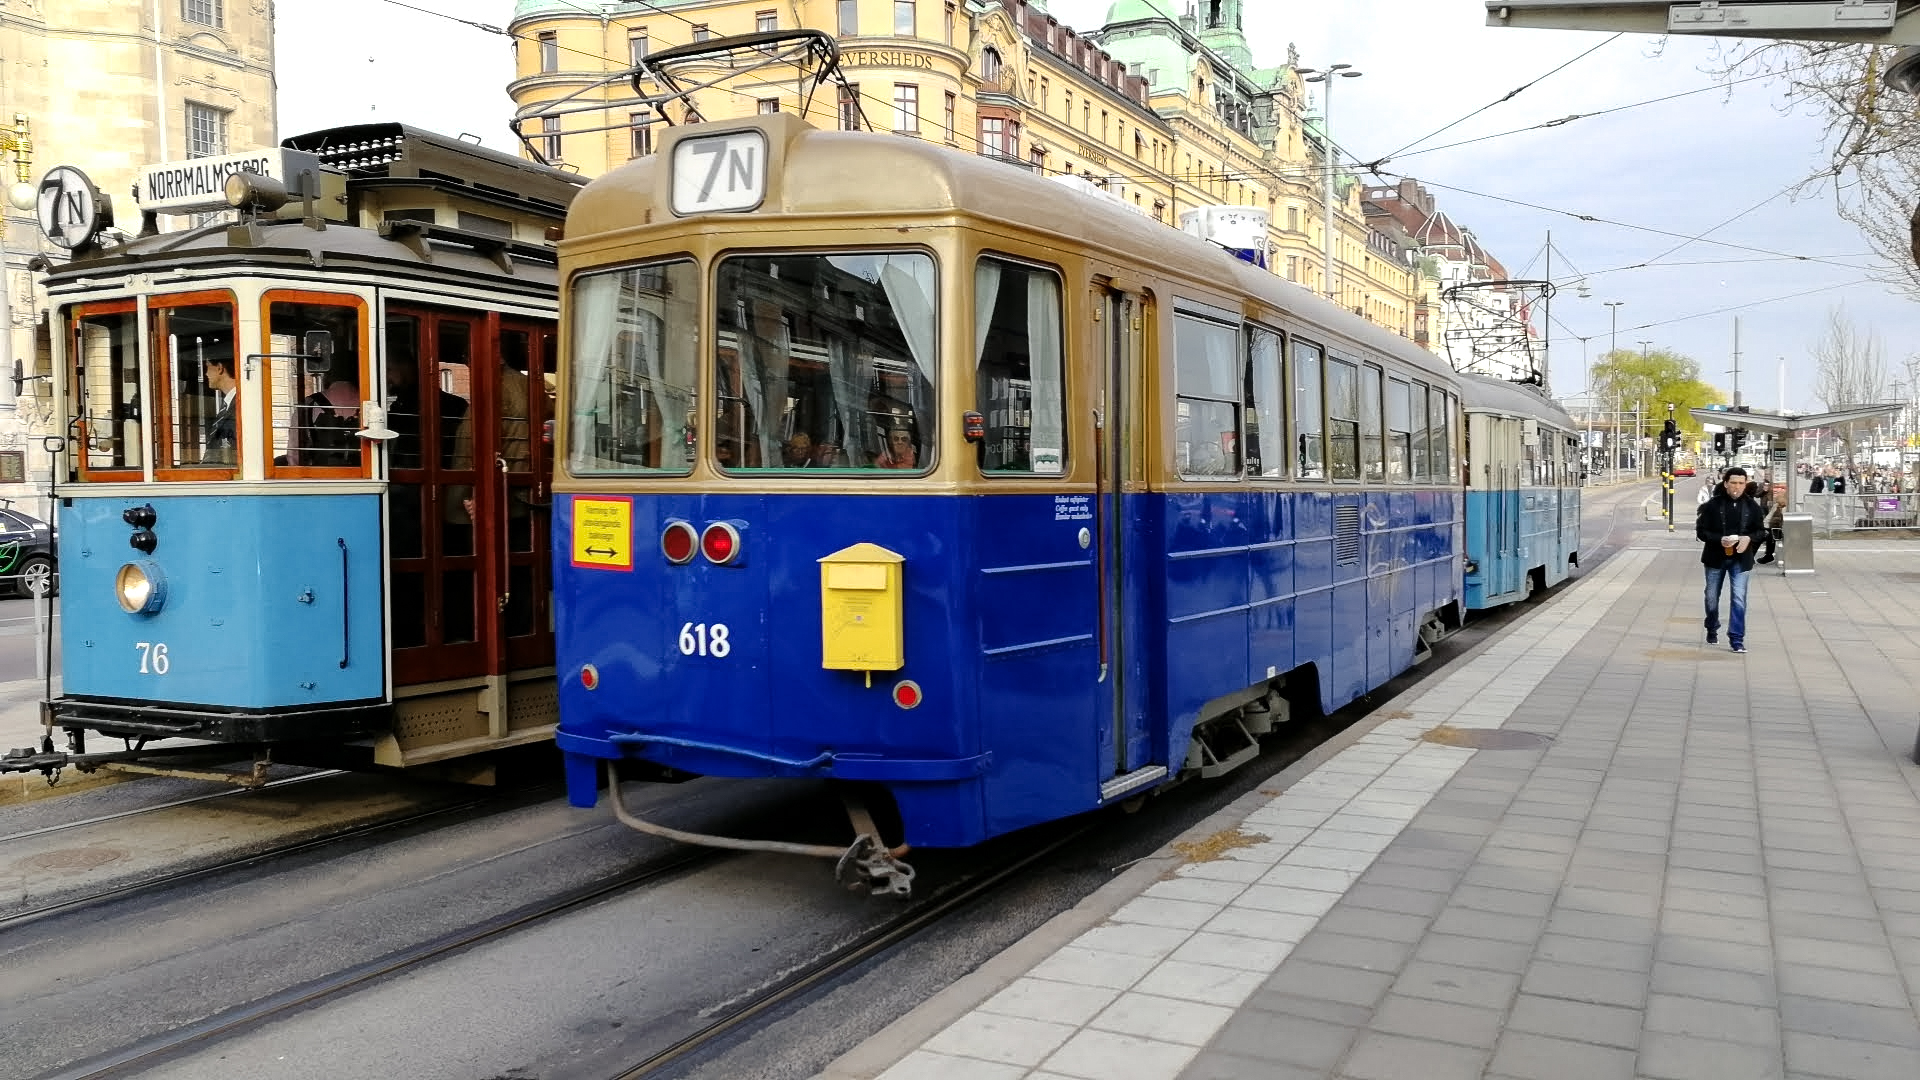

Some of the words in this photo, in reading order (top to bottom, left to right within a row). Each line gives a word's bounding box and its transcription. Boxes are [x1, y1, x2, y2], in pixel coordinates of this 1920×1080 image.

[837, 51, 933, 70] EVERSHEDS
[692, 140, 755, 204] 7N
[40, 178, 84, 237] 7N
[679, 621, 731, 658] 618
[135, 642, 169, 675] 76
